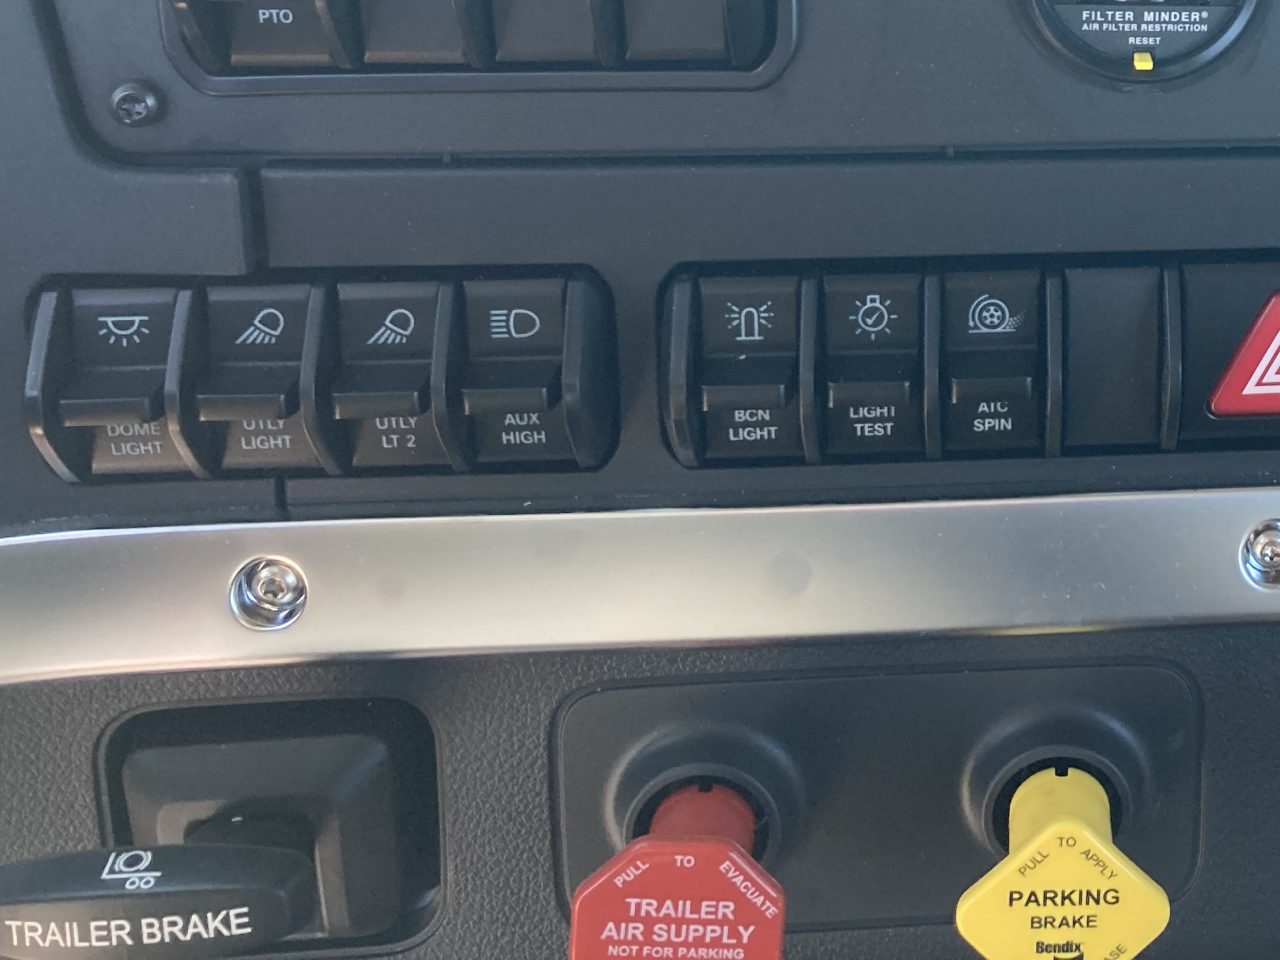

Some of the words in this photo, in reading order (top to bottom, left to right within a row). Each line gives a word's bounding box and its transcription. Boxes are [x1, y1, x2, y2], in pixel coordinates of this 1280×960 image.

[257, 8, 294, 24] PTO
[1082, 10, 1134, 21] FILTER
[1081, 22, 1100, 31] AIR
[1102, 23, 1138, 32] FILTER
[1140, 23, 1208, 32] RESTRICTION
[1128, 36, 1161, 45] RESET
[504, 412, 540, 426] AUX
[734, 408, 770, 422] BCN
[849, 406, 895, 419] LIGHT
[107, 423, 161, 437] DOME
[375, 416, 418, 430] UTLY
[853, 422, 894, 437] TEST
[973, 417, 1013, 432] SPIN
[501, 431, 547, 445] HIGH
[728, 426, 778, 441] LIGHT
[110, 440, 163, 456] LIGHT
[240, 435, 292, 450] LIGHT
[381, 435, 400, 449] LT
[405, 434, 417, 448] 2
[1017, 849, 1050, 878] PULL
[1057, 836, 1077, 848] TO
[1080, 848, 1119, 881] APPLY
[613, 859, 651, 888] PULL
[674, 854, 696, 868] TO
[718, 859, 780, 920] EVACUATE
[1008, 888, 1121, 908] PARKING
[625, 897, 736, 920] TRAILER
[4, 919, 134, 948] TRAILER
[140, 906, 253, 945] BRAKE
[1030, 914, 1099, 930] BRAKE
[600, 921, 645, 941] AIR
[652, 923, 756, 945] SUPPLY
[608, 944, 640, 957] NOT
[643, 945, 674, 958] FOR
[678, 946, 745, 960] PARKING
[1035, 940, 1083, 954] Bendix
